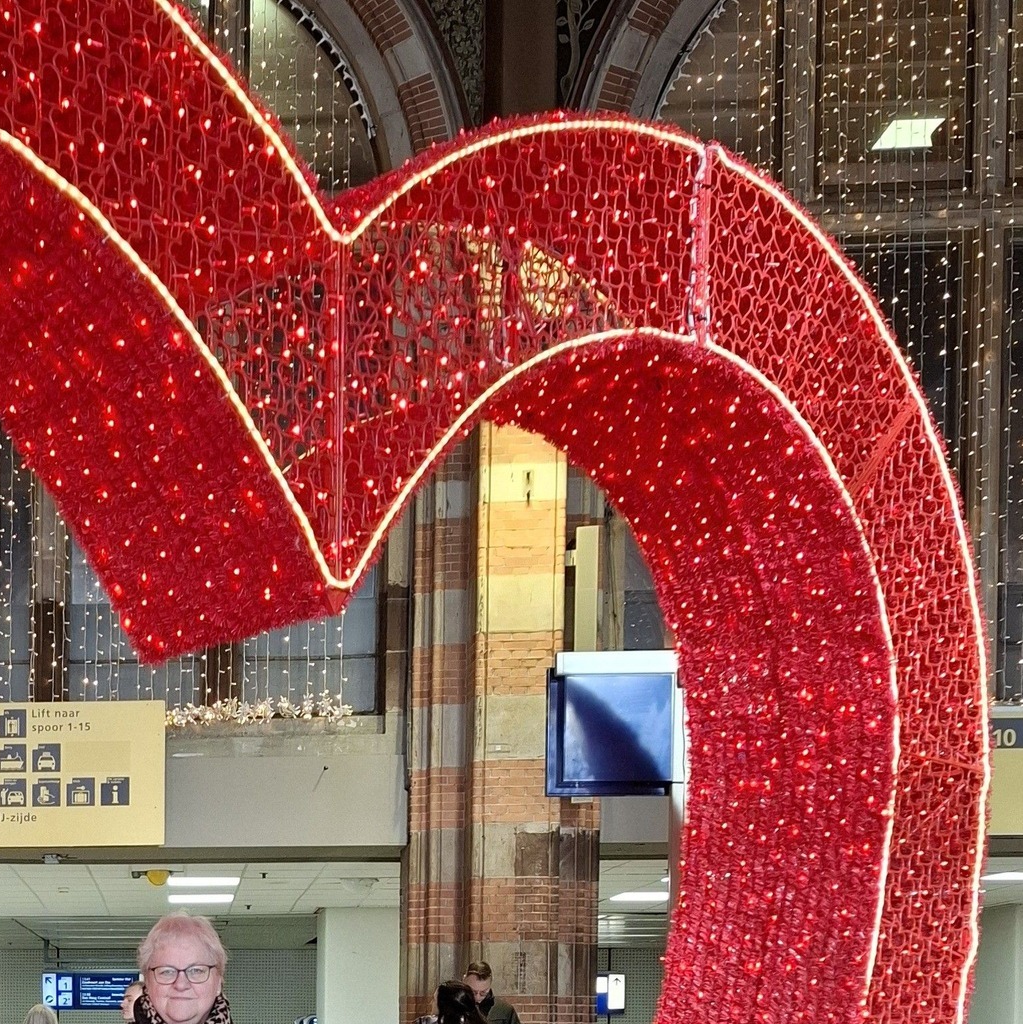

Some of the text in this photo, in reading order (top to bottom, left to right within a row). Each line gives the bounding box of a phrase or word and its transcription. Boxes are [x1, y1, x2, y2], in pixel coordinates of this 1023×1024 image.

[31, 708, 80, 718] Lift naar
[32, 722, 91, 734] spoor 1-15
[992, 728, 1017, 747] 10
[64, 982, 68, 990] 1
